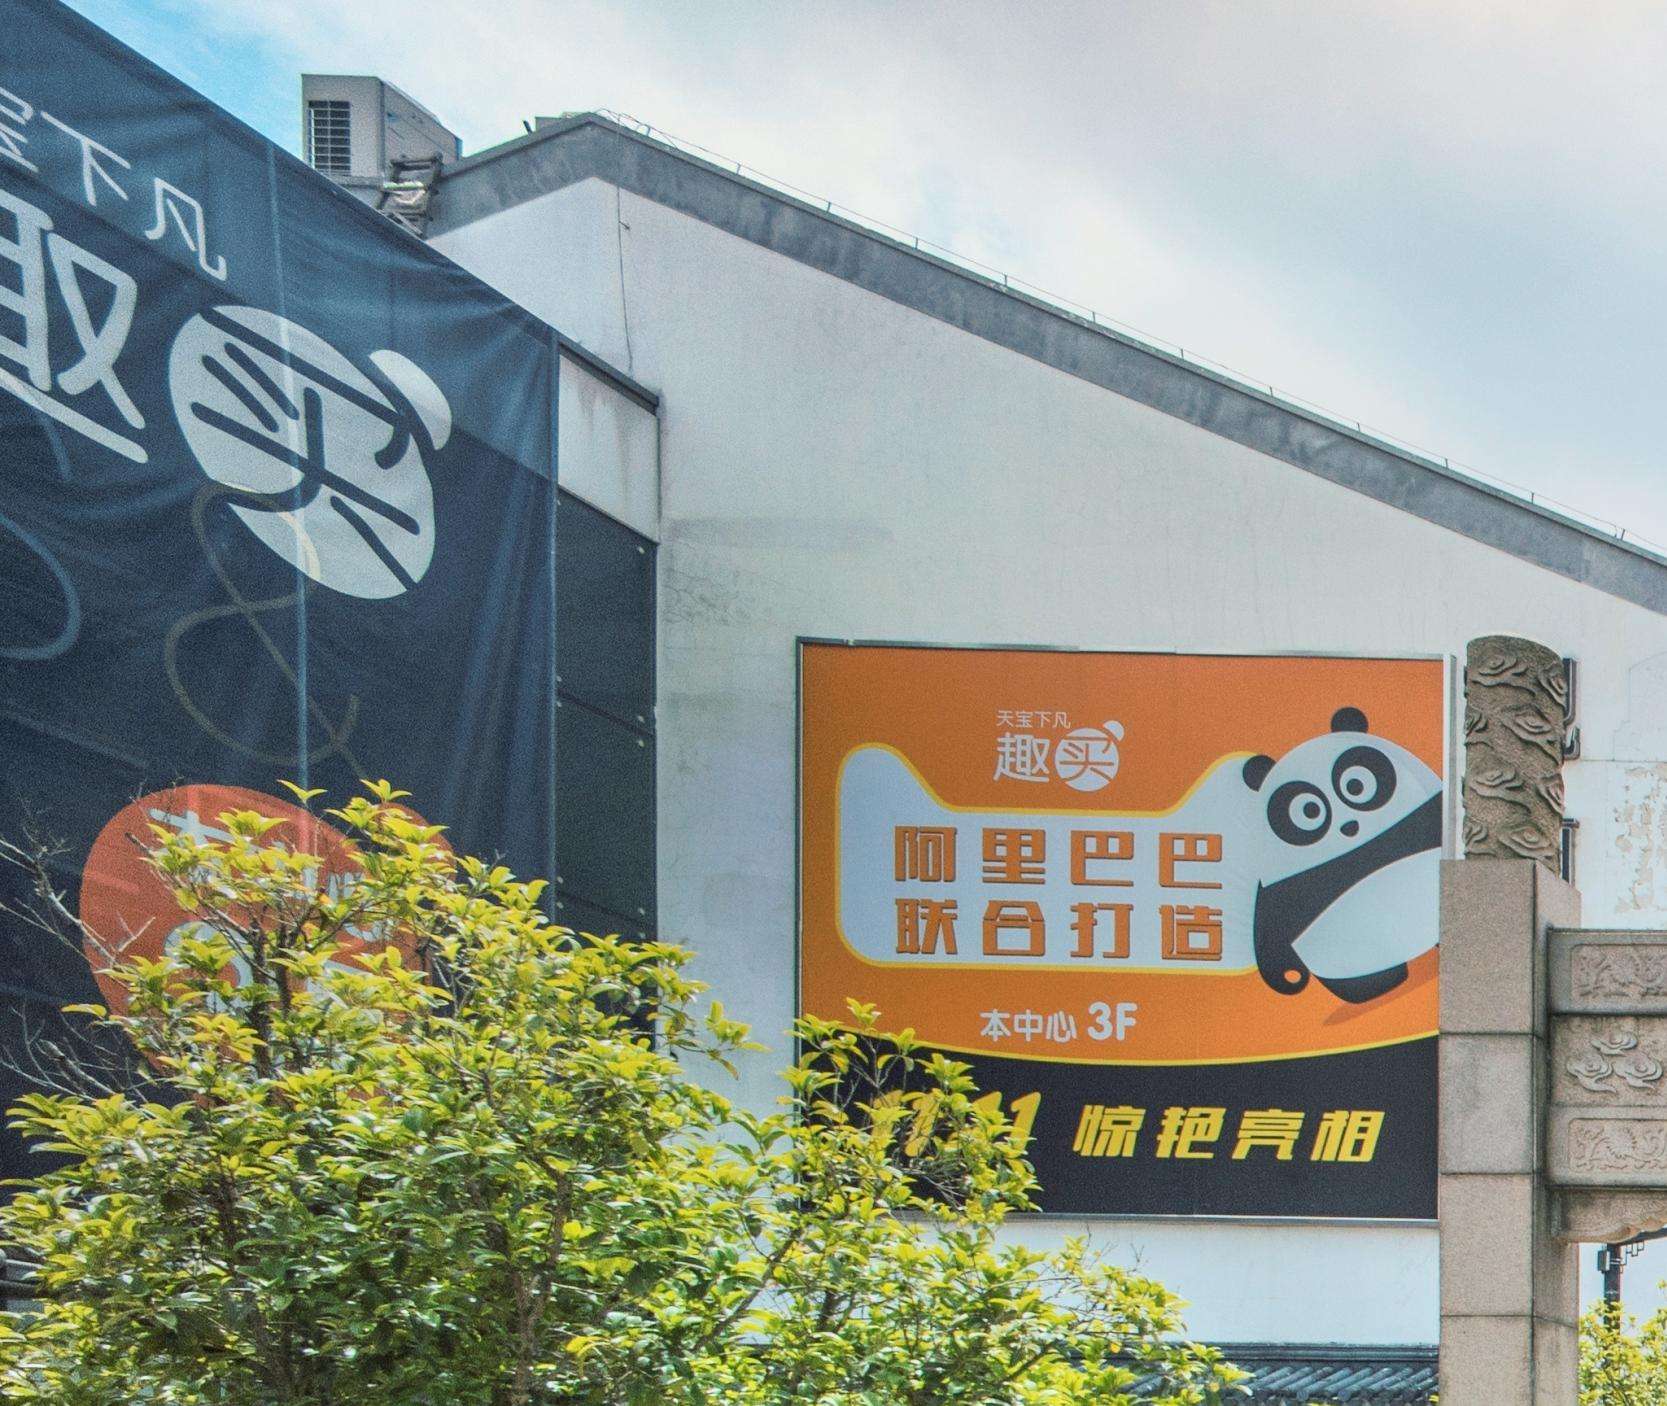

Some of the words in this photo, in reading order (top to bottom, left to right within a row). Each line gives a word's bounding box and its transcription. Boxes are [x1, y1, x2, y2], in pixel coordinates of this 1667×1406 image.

[996, 710, 1071, 729] 天宝下凡
[895, 826, 1222, 889] 阿里巴巴
[895, 898, 1222, 961] 联合打造
[980, 1009, 1077, 1042] 本中心
[1087, 1002, 1137, 1041] 3F
[1072, 1104, 1385, 1163] 惊艳亮相
